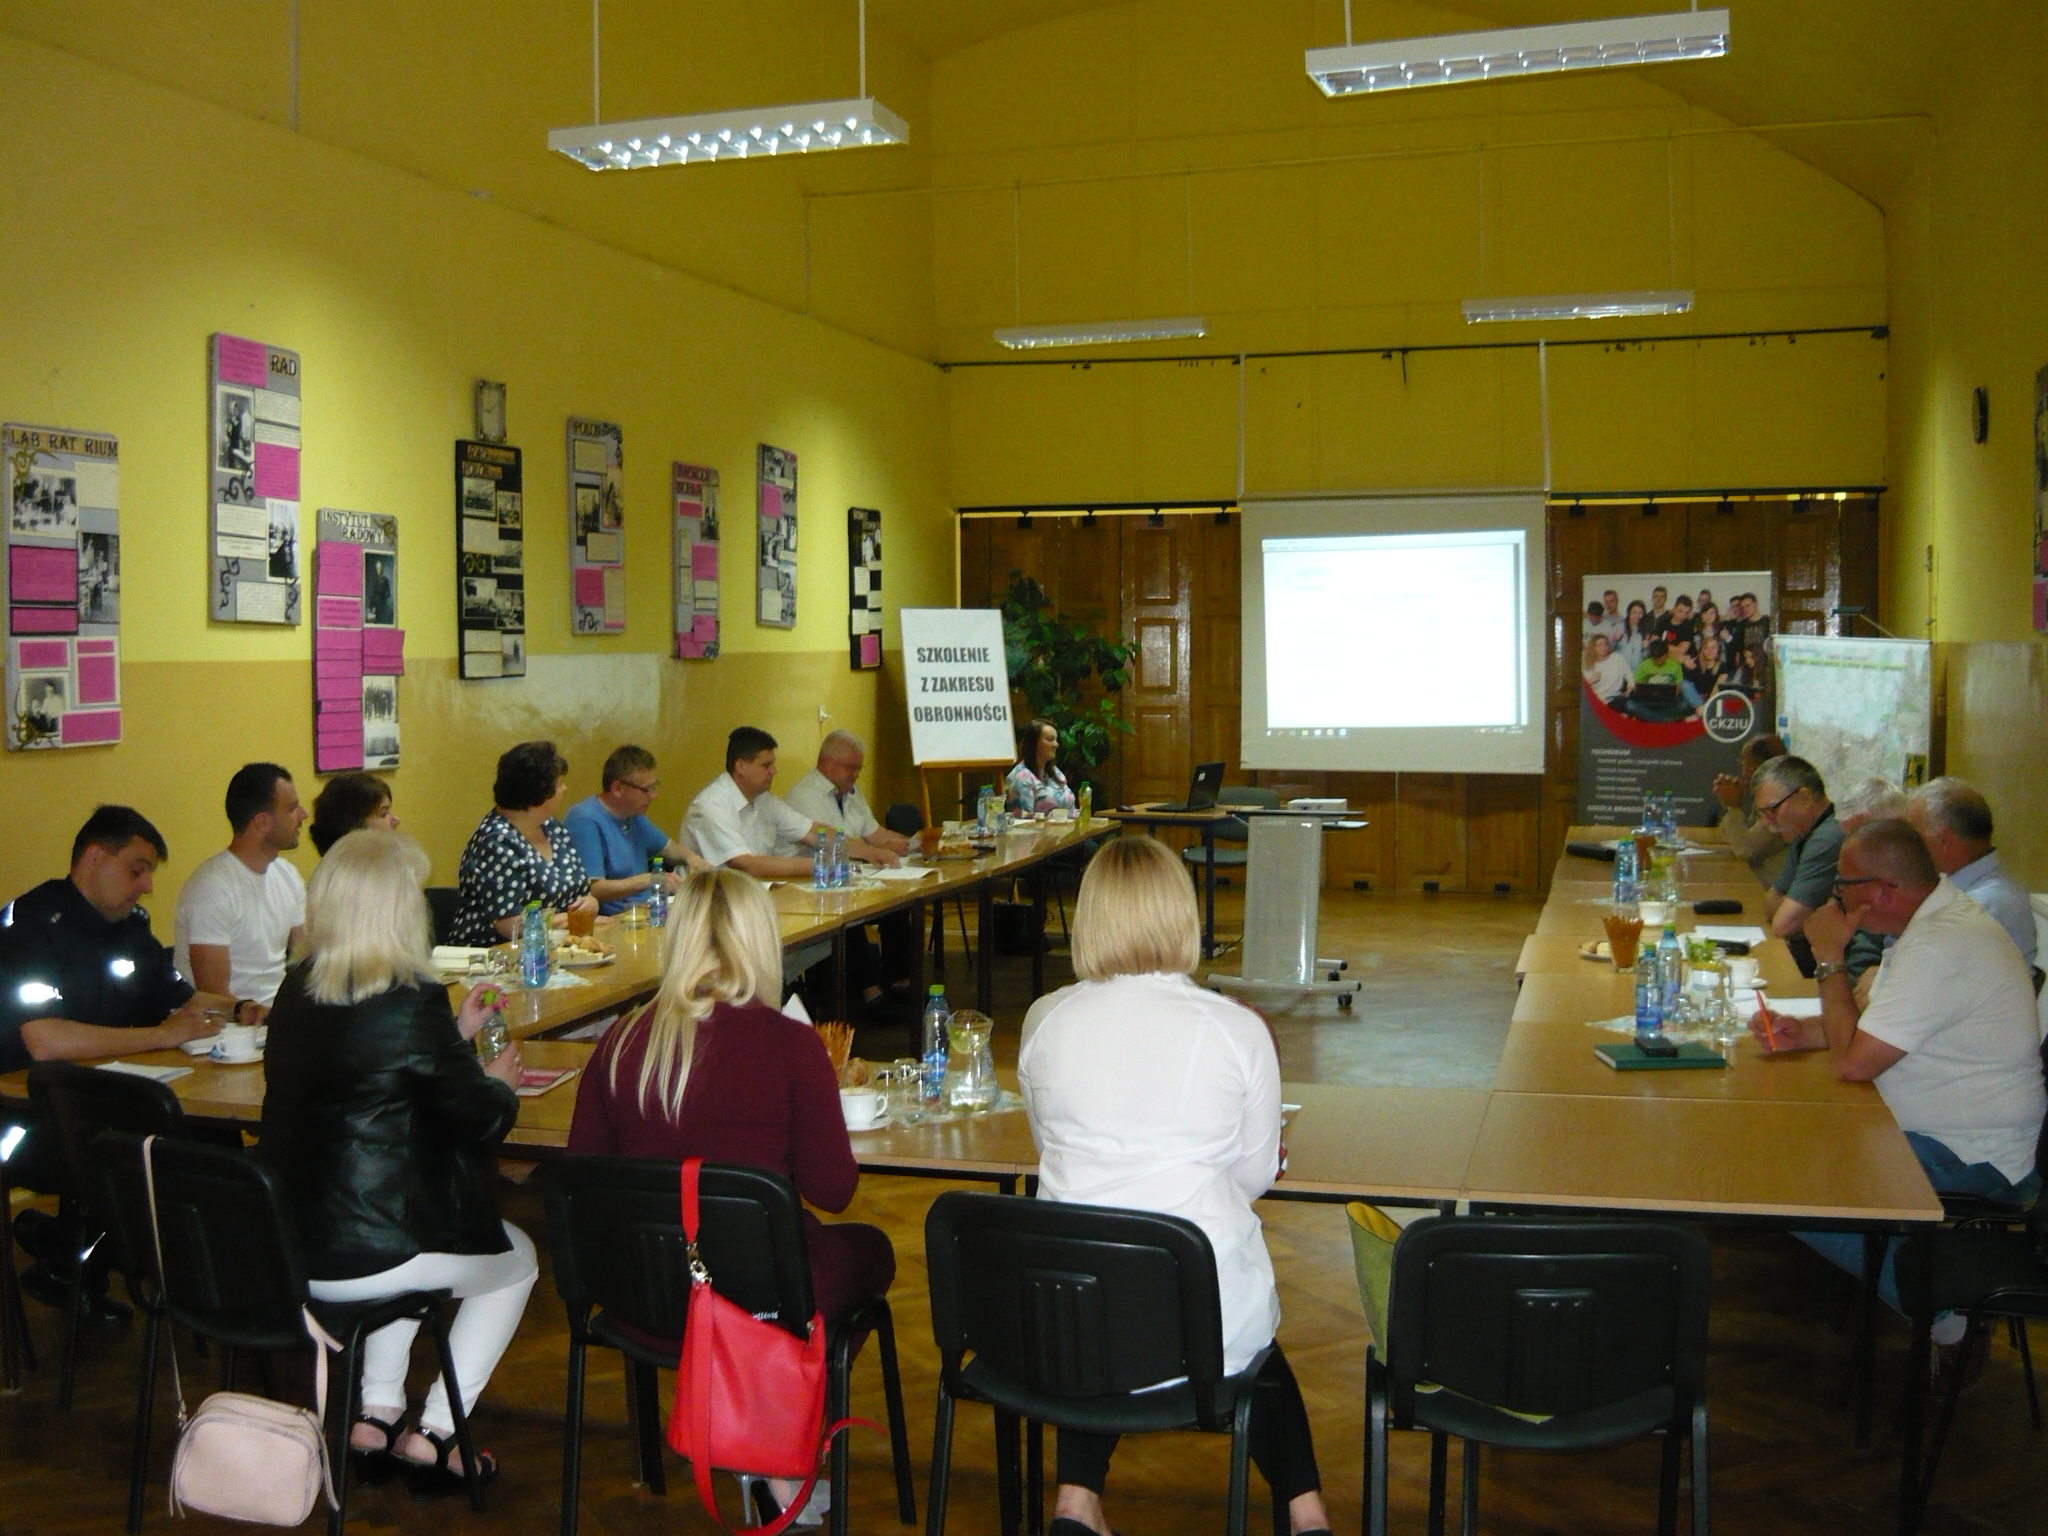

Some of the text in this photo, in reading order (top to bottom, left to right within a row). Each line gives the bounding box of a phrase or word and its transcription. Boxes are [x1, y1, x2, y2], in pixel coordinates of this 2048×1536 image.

[270, 354, 297, 376] RAD
[917, 647, 990, 663] SZKOLENIE
[921, 676, 995, 693] Z ZAKRESU
[913, 703, 1008, 723] OBRONNOŚCI
[1709, 718, 1749, 731] CKZIU
